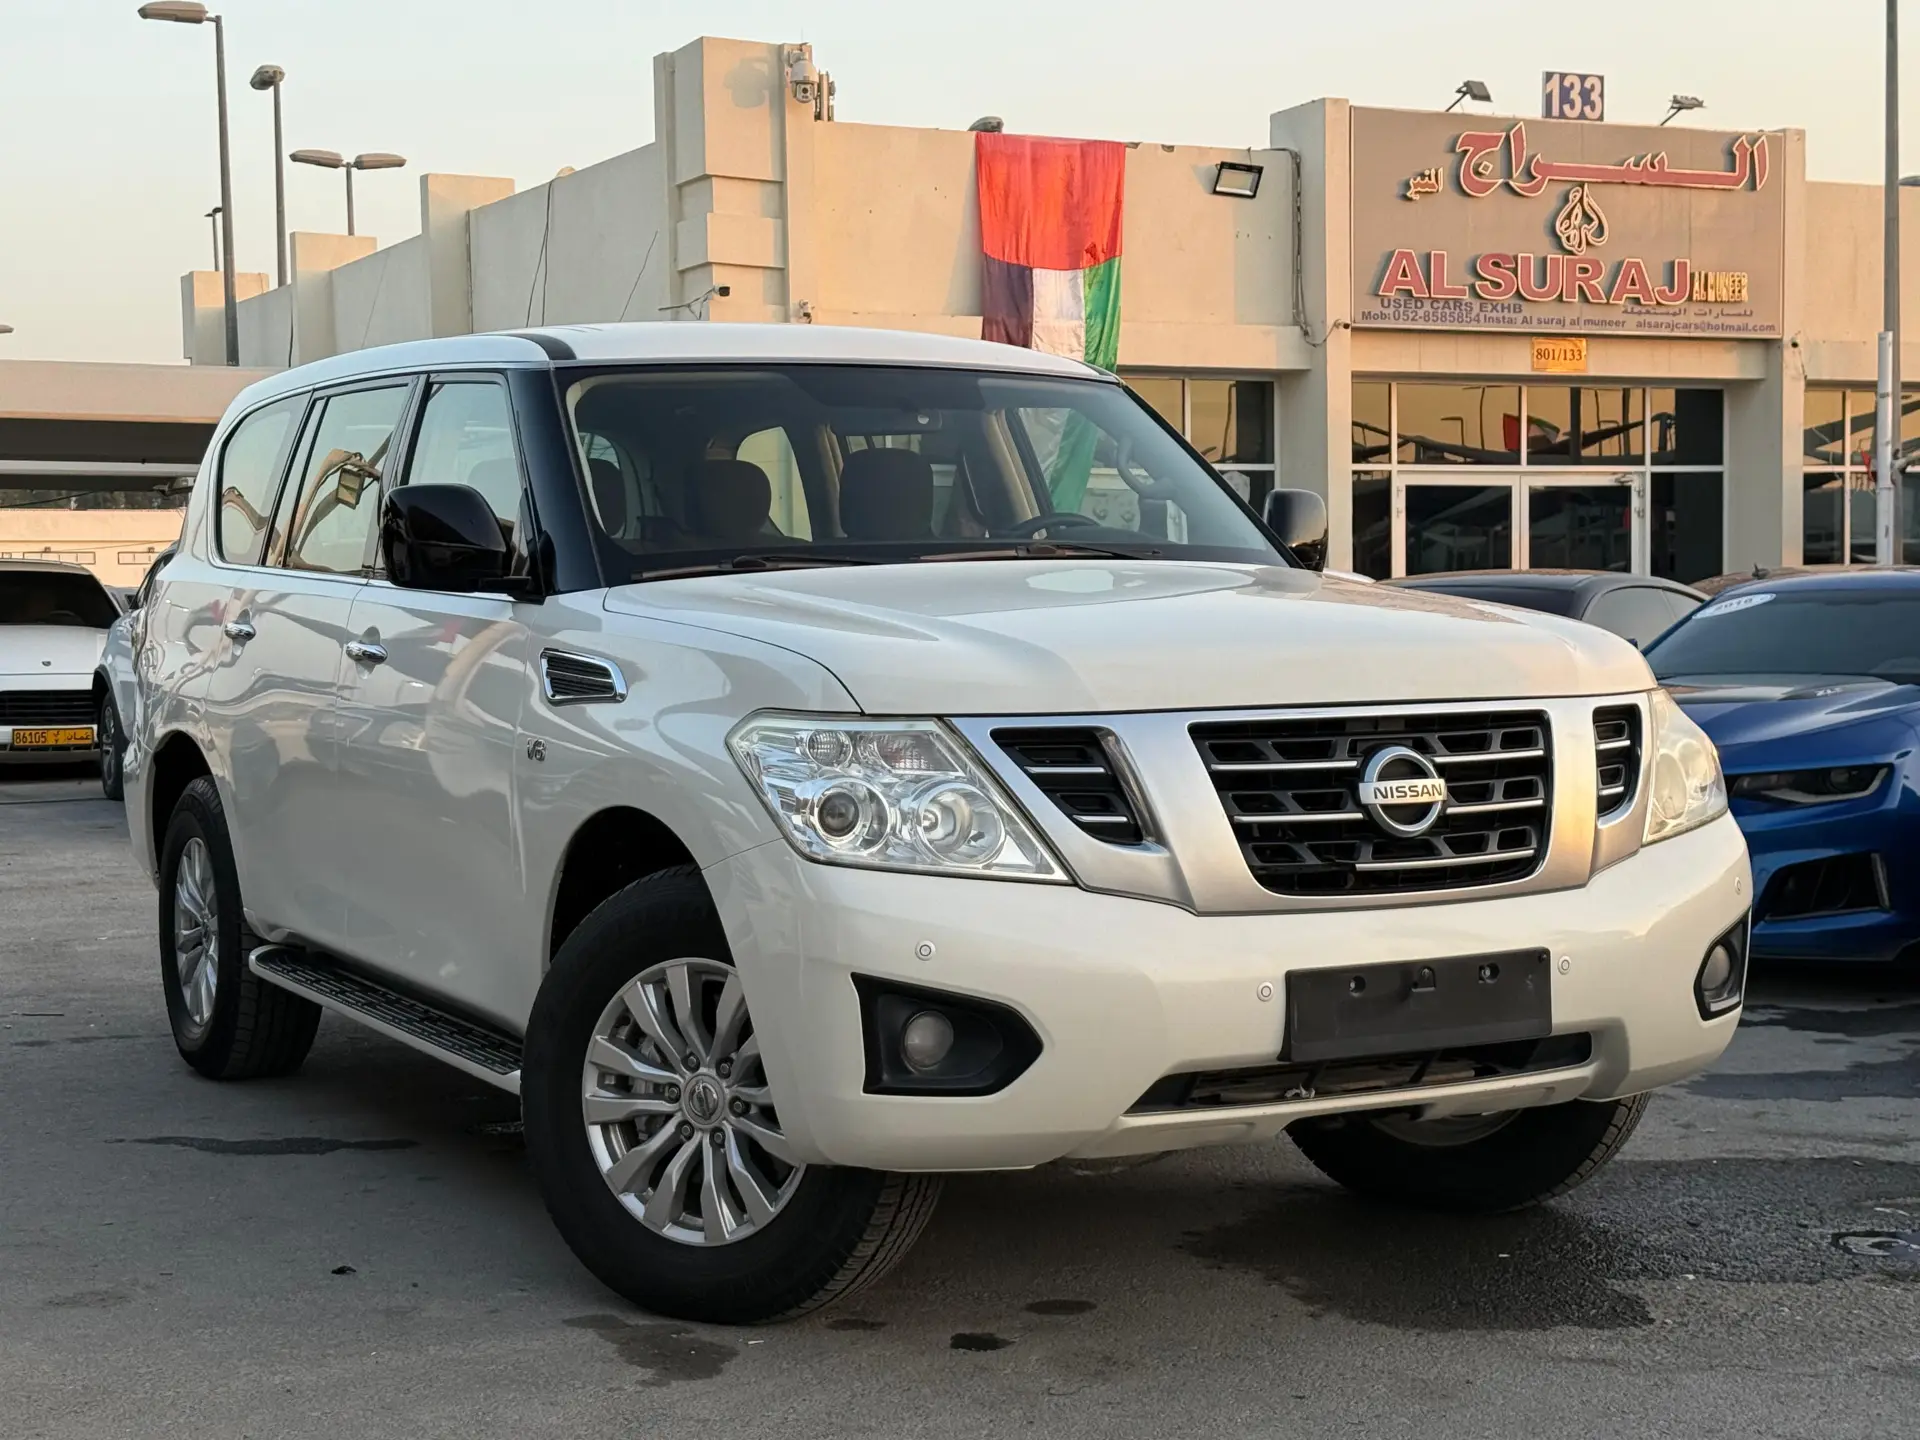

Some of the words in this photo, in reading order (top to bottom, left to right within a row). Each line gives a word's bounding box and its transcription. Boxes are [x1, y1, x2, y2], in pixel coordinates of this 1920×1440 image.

[1545, 73, 1602, 119] 133
[1456, 121, 1769, 197] السراج
[1379, 249, 1469, 299] AL
[1475, 253, 1690, 305] SURAJ
[1380, 298, 1424, 310] USED
[1430, 301, 1474, 313] CARS
[1479, 302, 1523, 314] EXHB
[1361, 310, 1391, 322] Mob:
[1393, 309, 1481, 324] 052-8585854
[1483, 314, 1517, 325] Insta:
[1537, 316, 1566, 328] suraj
[1569, 317, 1580, 326] al
[1583, 318, 1626, 328] muneer
[1535, 347, 1582, 361] 801/133
[15, 731, 47, 744] 86105
[1373, 783, 1442, 800] NISSAN
